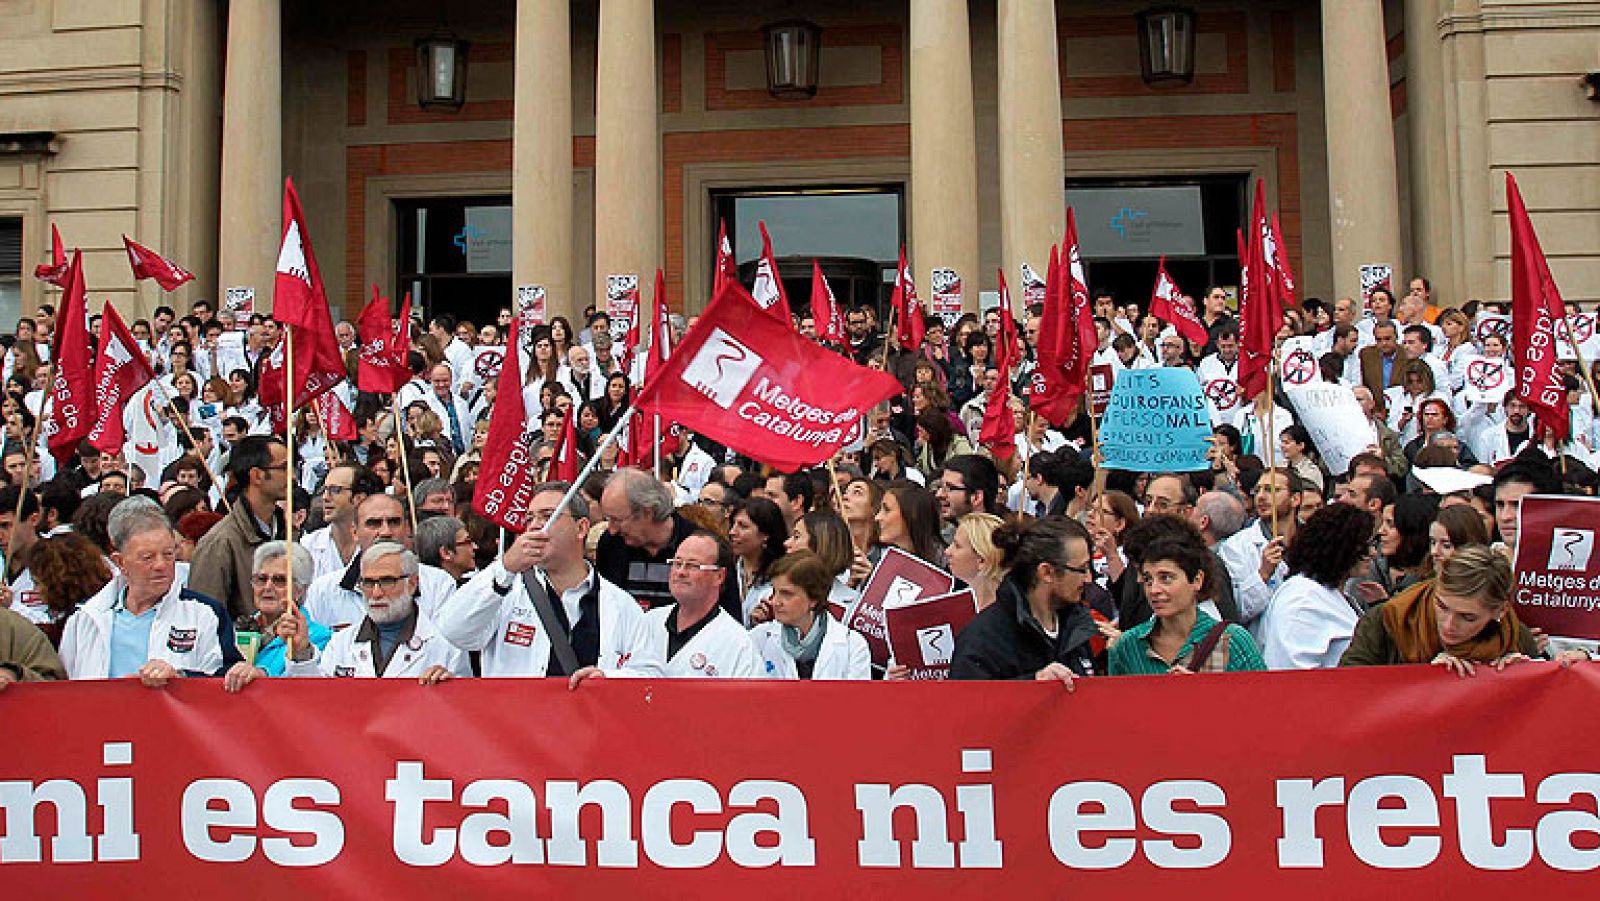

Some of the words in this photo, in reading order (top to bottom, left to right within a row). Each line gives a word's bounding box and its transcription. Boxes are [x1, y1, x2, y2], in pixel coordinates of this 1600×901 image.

[753, 377, 833, 424] Metges
[738, 402, 842, 447] Catalunya
[1518, 571, 1586, 592] Metges
[0, 742, 140, 863] ni
[181, 778, 345, 867] es
[385, 761, 816, 868] tanca
[854, 749, 1003, 869] ni
[1047, 779, 1233, 870] es
[1276, 754, 1600, 871] reta
